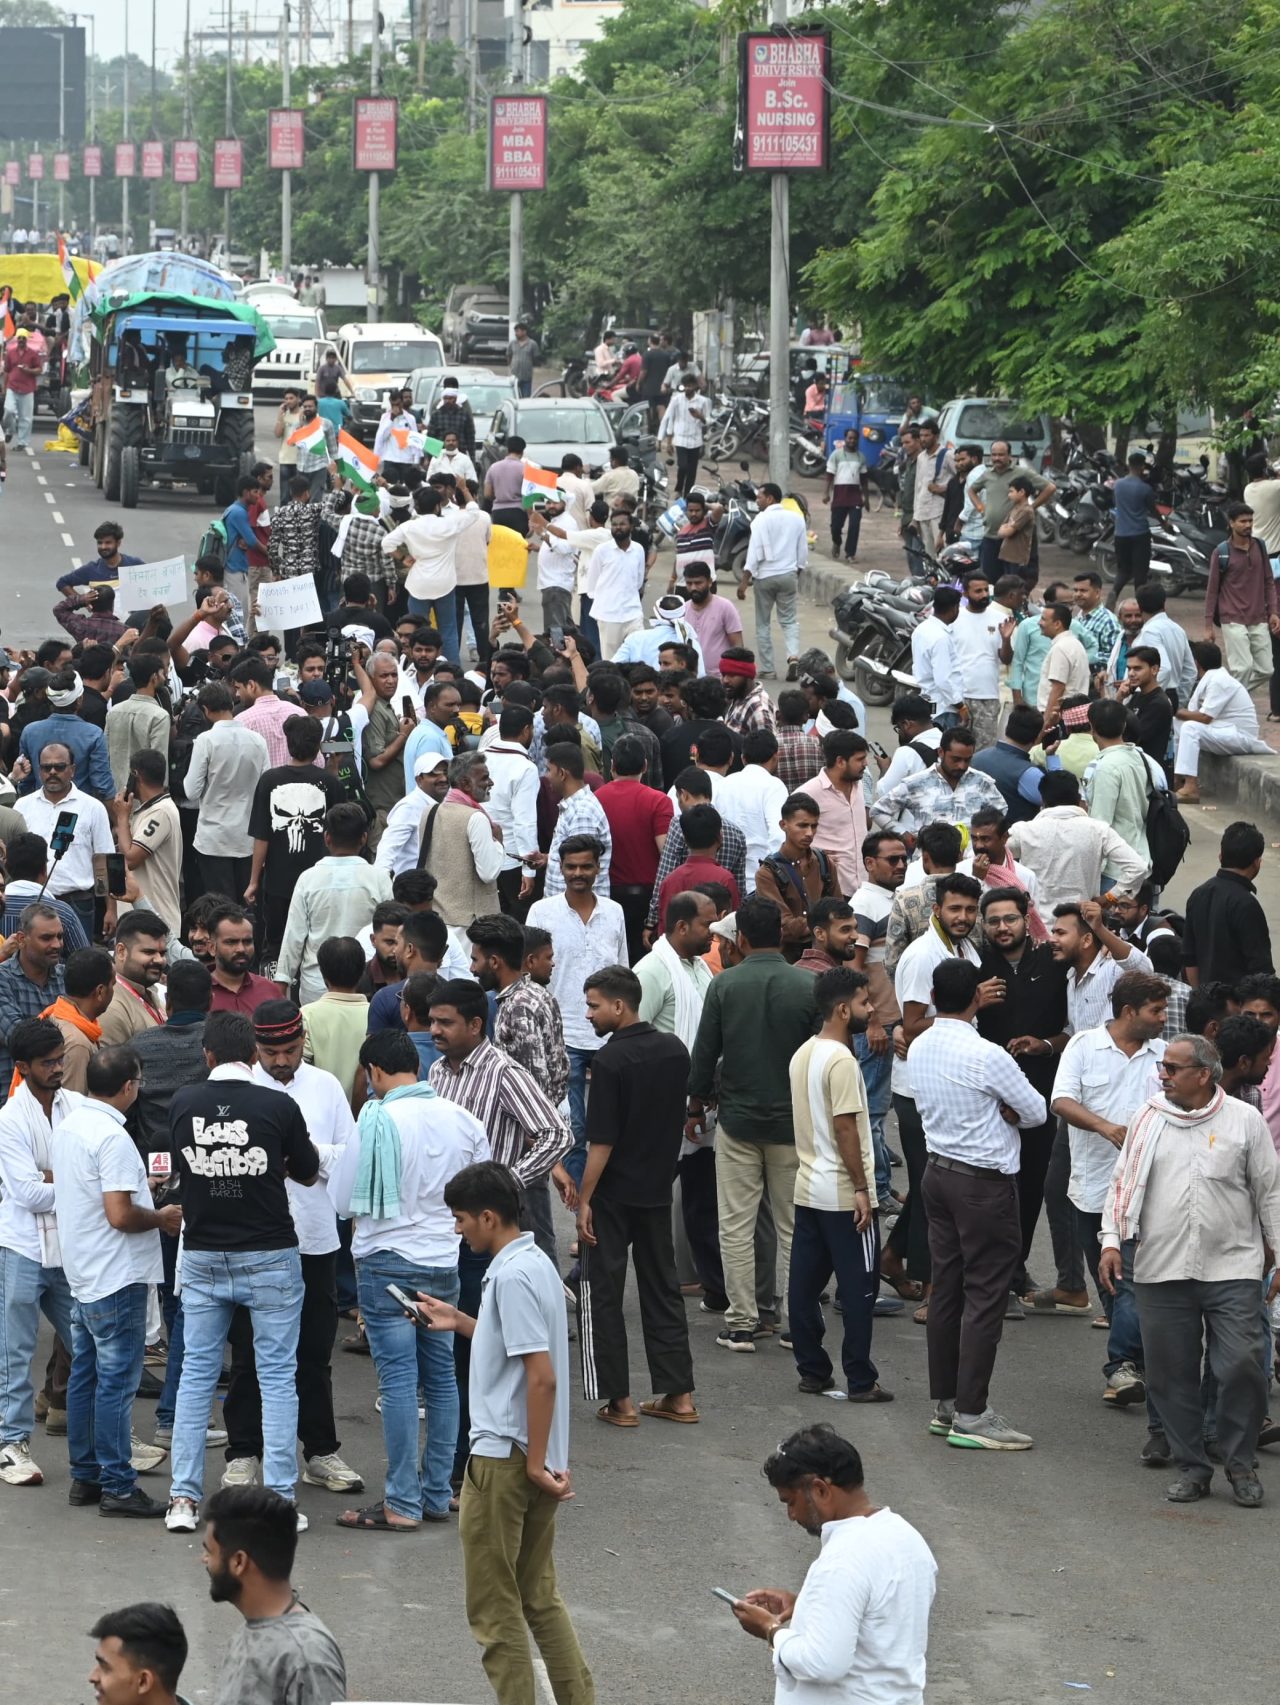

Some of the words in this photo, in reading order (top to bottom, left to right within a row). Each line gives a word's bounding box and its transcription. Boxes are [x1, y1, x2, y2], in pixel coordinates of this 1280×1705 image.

[770, 43, 820, 64] BHABHA
[754, 65, 822, 76] UNIVERSITY
[778, 78, 796, 88] Join
[765, 90, 808, 108] B.Sc.
[506, 102, 541, 116] BHABHA
[495, 117, 543, 125] UNIVERSITY
[757, 113, 816, 126] NURSING
[502, 135, 535, 147] MBA
[753, 136, 817, 153] 9111105431
[503, 151, 534, 163] BBA
[143, 819, 160, 837] 5
[209, 1179, 241, 1190] 1854
[209, 1189, 244, 1199] PARIS
